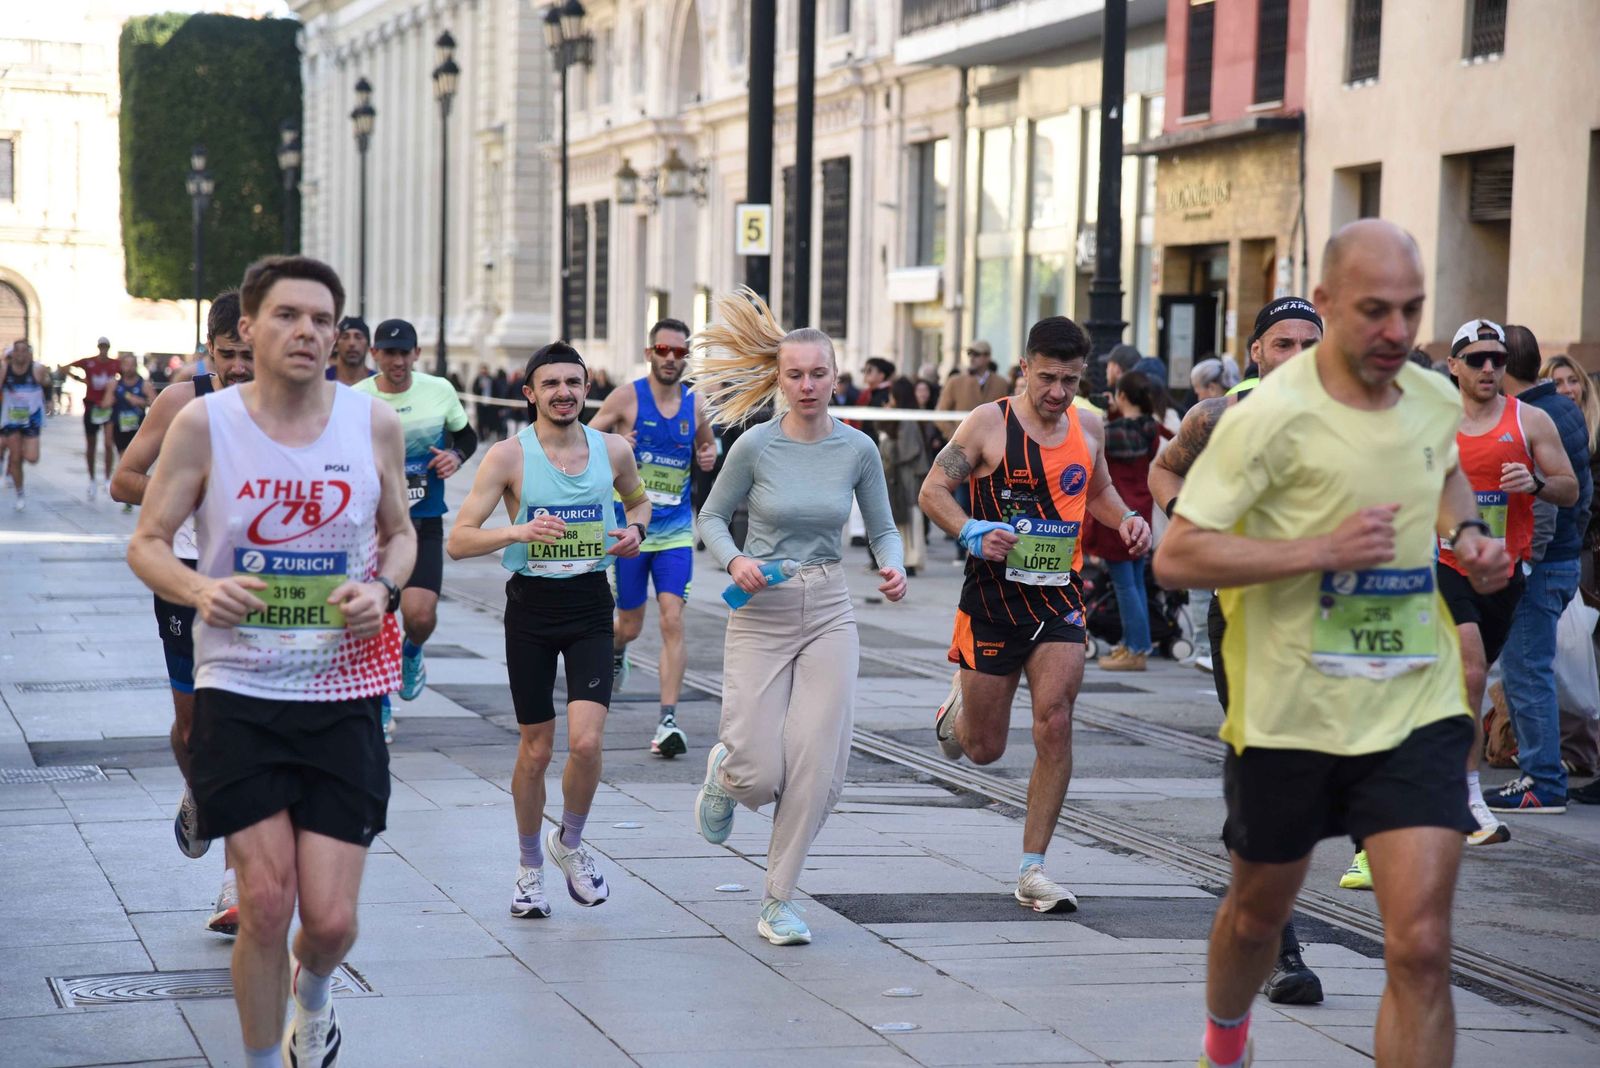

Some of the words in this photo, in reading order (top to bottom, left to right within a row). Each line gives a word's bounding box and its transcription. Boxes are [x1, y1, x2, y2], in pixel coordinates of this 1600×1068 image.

[747, 217, 761, 242] 5
[1269, 303, 1289, 315] LIKE
[1297, 303, 1316, 314] PRO
[324, 464, 349, 472] POLI
[654, 455, 684, 467] ZURICH
[236, 479, 324, 500] ATHLE
[281, 500, 322, 526] 78
[554, 509, 595, 520] ZURICH
[1034, 543, 1056, 553] 2178
[271, 557, 335, 571] ZURICH
[1024, 553, 1061, 570] LÓPEZ
[1362, 574, 1426, 590] ZURICH
[273, 586, 306, 600] 3196
[246, 606, 331, 625] PIERREL
[1349, 628, 1404, 652] YVES
